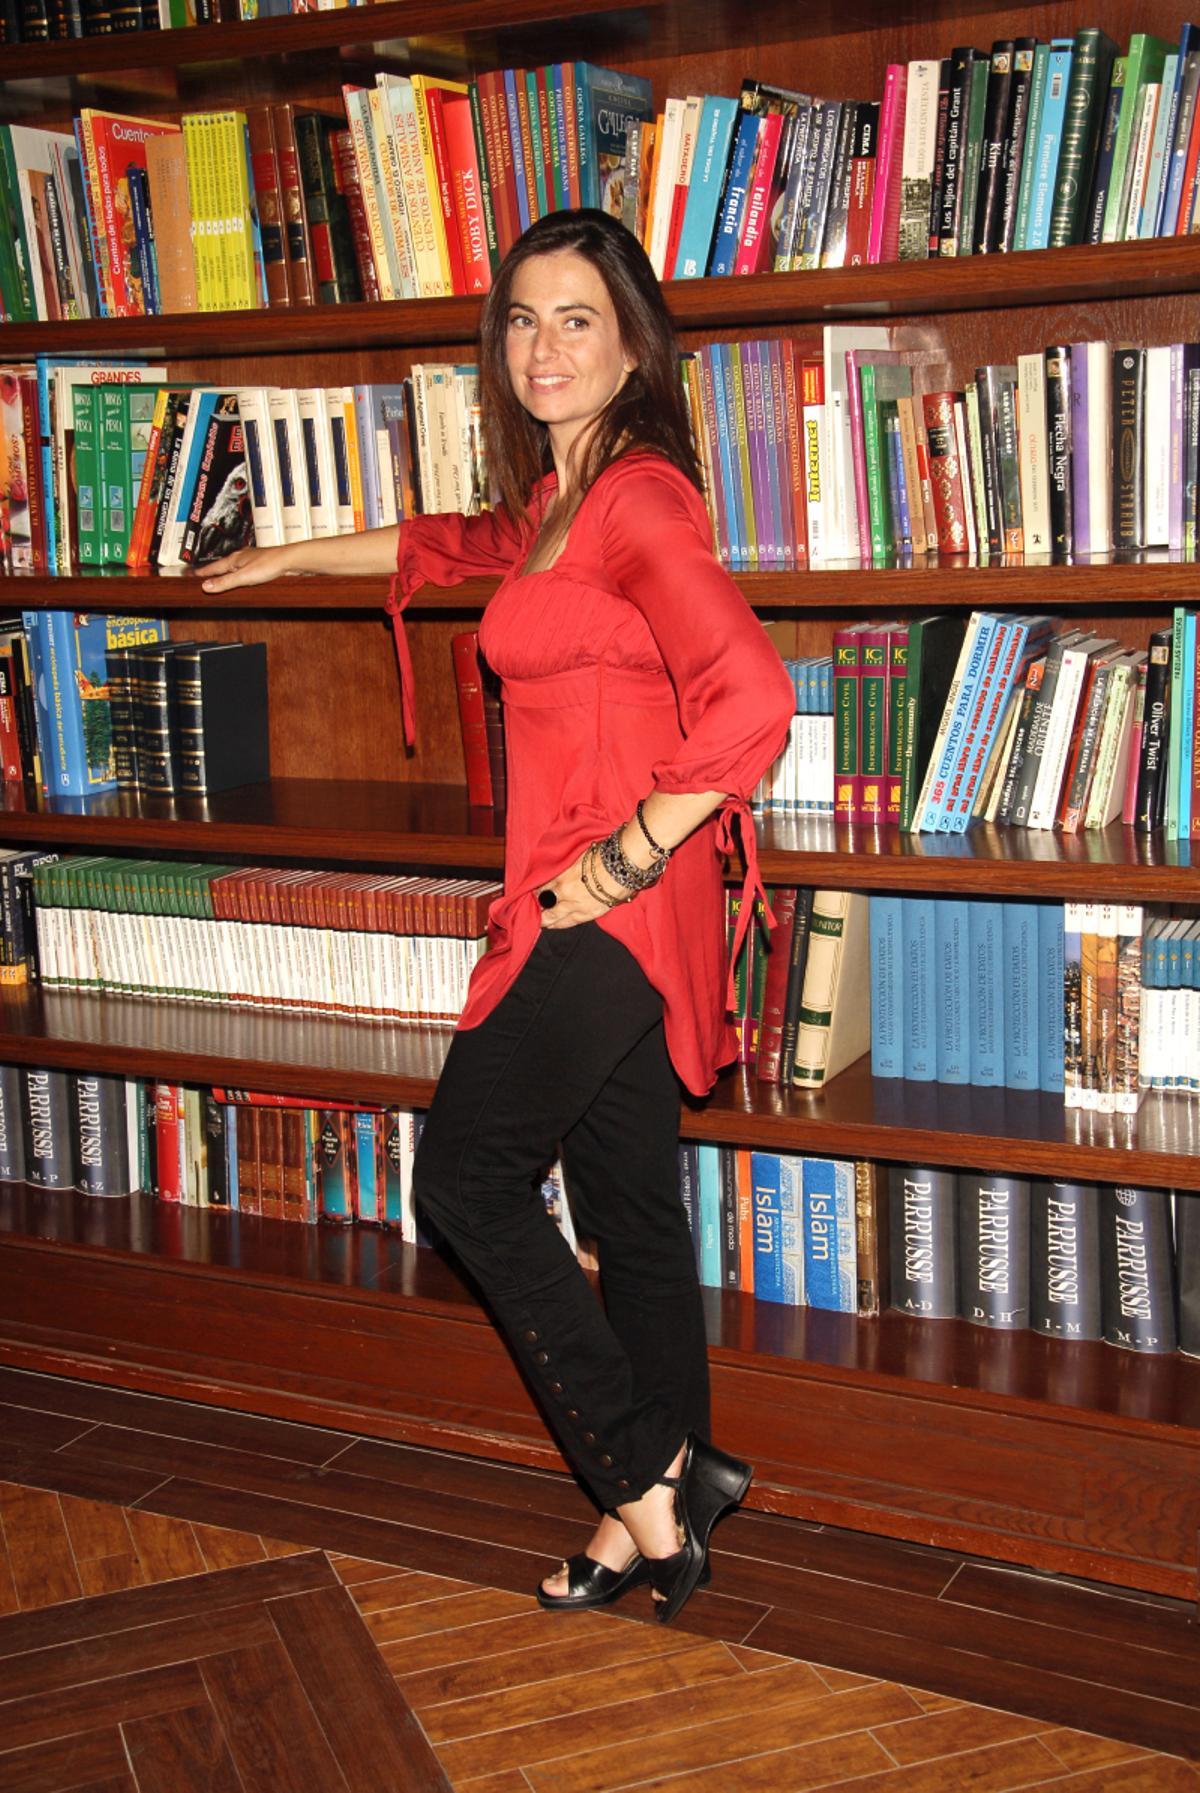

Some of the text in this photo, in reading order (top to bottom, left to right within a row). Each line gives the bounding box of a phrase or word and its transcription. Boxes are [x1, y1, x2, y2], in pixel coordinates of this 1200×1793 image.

[498, 93, 507, 127] COCINA
[528, 91, 536, 126] COCINA
[539, 90, 547, 124] COCINA
[548, 90, 556, 125] COCINA
[555, 88, 565, 142] PRODUCTOS
[576, 87, 586, 165] COCINA GALLEGA
[112, 122, 154, 143] Cuent
[481, 98, 498, 188] COCINA VALENCIANA
[559, 144, 565, 156] DE
[861, 124, 870, 155] CIMA
[988, 142, 1001, 168] Kim
[1039, 134, 1053, 181] Premiere
[392, 169, 399, 177] EL
[394, 113, 424, 252] CUENTOS DE ANIMALES
[405, 111, 435, 251] CUENTOS DE ANIMALES
[678, 132, 692, 184] MATADERO
[942, 87, 961, 229] Los hijos del capitán Grant
[97, 144, 121, 275] Cuentos de Hadas para todos
[353, 118, 385, 255] CUENTOS DE ANIMALES
[379, 142, 409, 278] CUENTOS DE ANIMALES
[723, 185, 745, 235] francia
[1033, 182, 1047, 228] Elements
[462, 168, 483, 261] MOBY DICK
[744, 185, 766, 248] tailandia
[1032, 231, 1042, 247] 2.0
[1090, 234, 1099, 244] LA
[91, 371, 141, 384] GRANDES
[415, 374, 423, 398] Science
[703, 368, 712, 401] COCINA
[743, 363, 751, 397] COCINA
[752, 363, 760, 396] COCINA
[762, 365, 770, 398] COCINA
[805, 419, 821, 502] Internet
[1054, 413, 1067, 491] Flecha Negra
[1123, 379, 1134, 537] PETER STRAUB
[28, 476, 37, 514] VIENTO
[106, 626, 159, 650] básica
[841, 681, 849, 707] CIVIL
[868, 682, 876, 707] CIVIL
[896, 682, 905, 707] CIVIL
[931, 625, 990, 805] 365 CUENTOS PARA DORMIR
[945, 625, 1007, 812] mi gran libro de cuentos de animales
[905, 697, 916, 757] the community
[959, 626, 1023, 813] mi gran libro de cuentos de animales
[1026, 701, 1043, 754] MADERAS DE
[1033, 702, 1053, 757] ORIENTE
[1146, 702, 1163, 770] Oliver Twist
[879, 1034, 886, 1045] LA
[945, 1040, 952, 1050] LA
[979, 1042, 987, 1053] LA
[28, 1072, 54, 1159] PARRUSSE
[76, 1078, 103, 1167] PARRUSSE
[727, 1211, 734, 1223] de
[740, 1196, 749, 1221] Pubs
[755, 1185, 779, 1253] Islam
[809, 1192, 834, 1261] Islam
[904, 1178, 932, 1283] PARRUSSE
[727, 1225, 735, 1250] moda
[978, 1187, 1009, 1294] PARRUSSE
[1047, 1196, 1077, 1306] PARRUSSE
[1115, 1214, 1152, 1320] PARRUSSE
